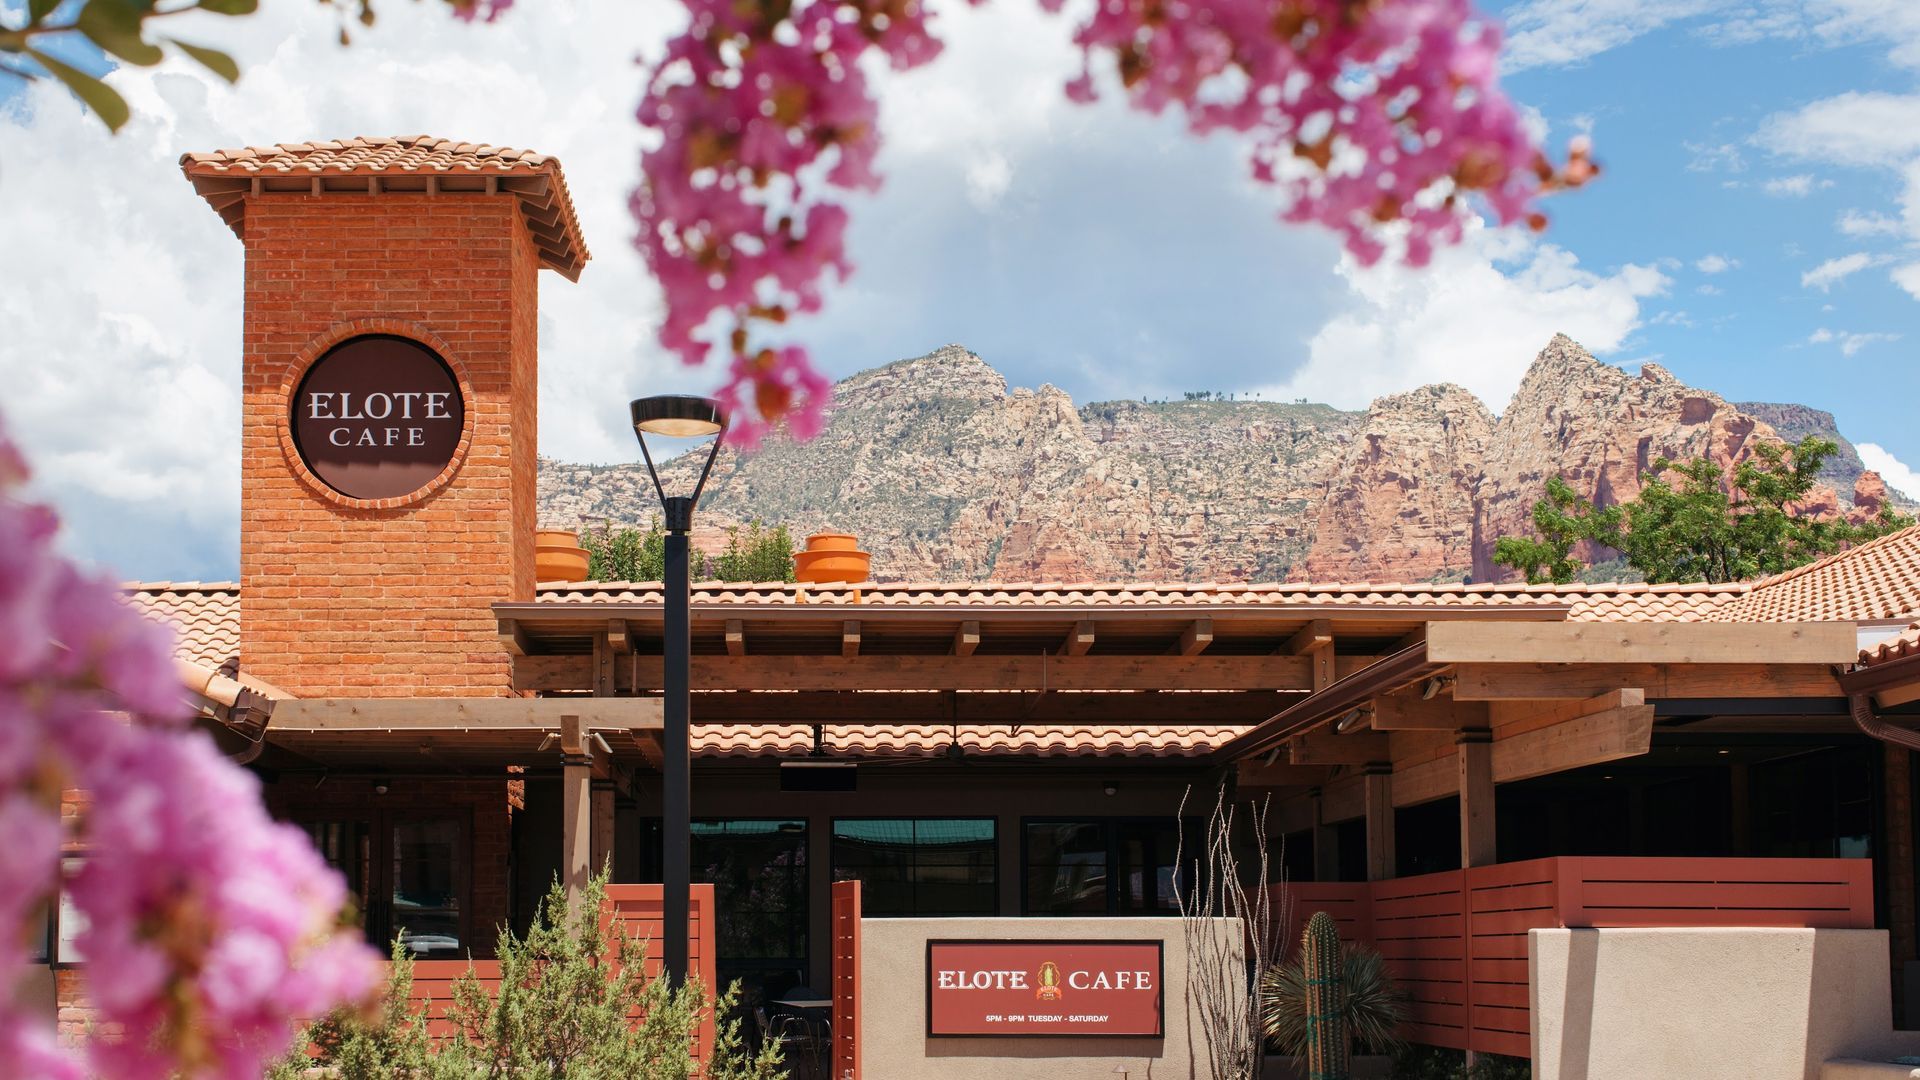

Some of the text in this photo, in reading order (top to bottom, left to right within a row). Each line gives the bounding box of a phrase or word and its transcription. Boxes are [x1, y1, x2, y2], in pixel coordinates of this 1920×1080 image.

[307, 392, 452, 419] ELOTE
[329, 427, 425, 447] CAFE
[937, 970, 1152, 989] ELOTE CAFE
